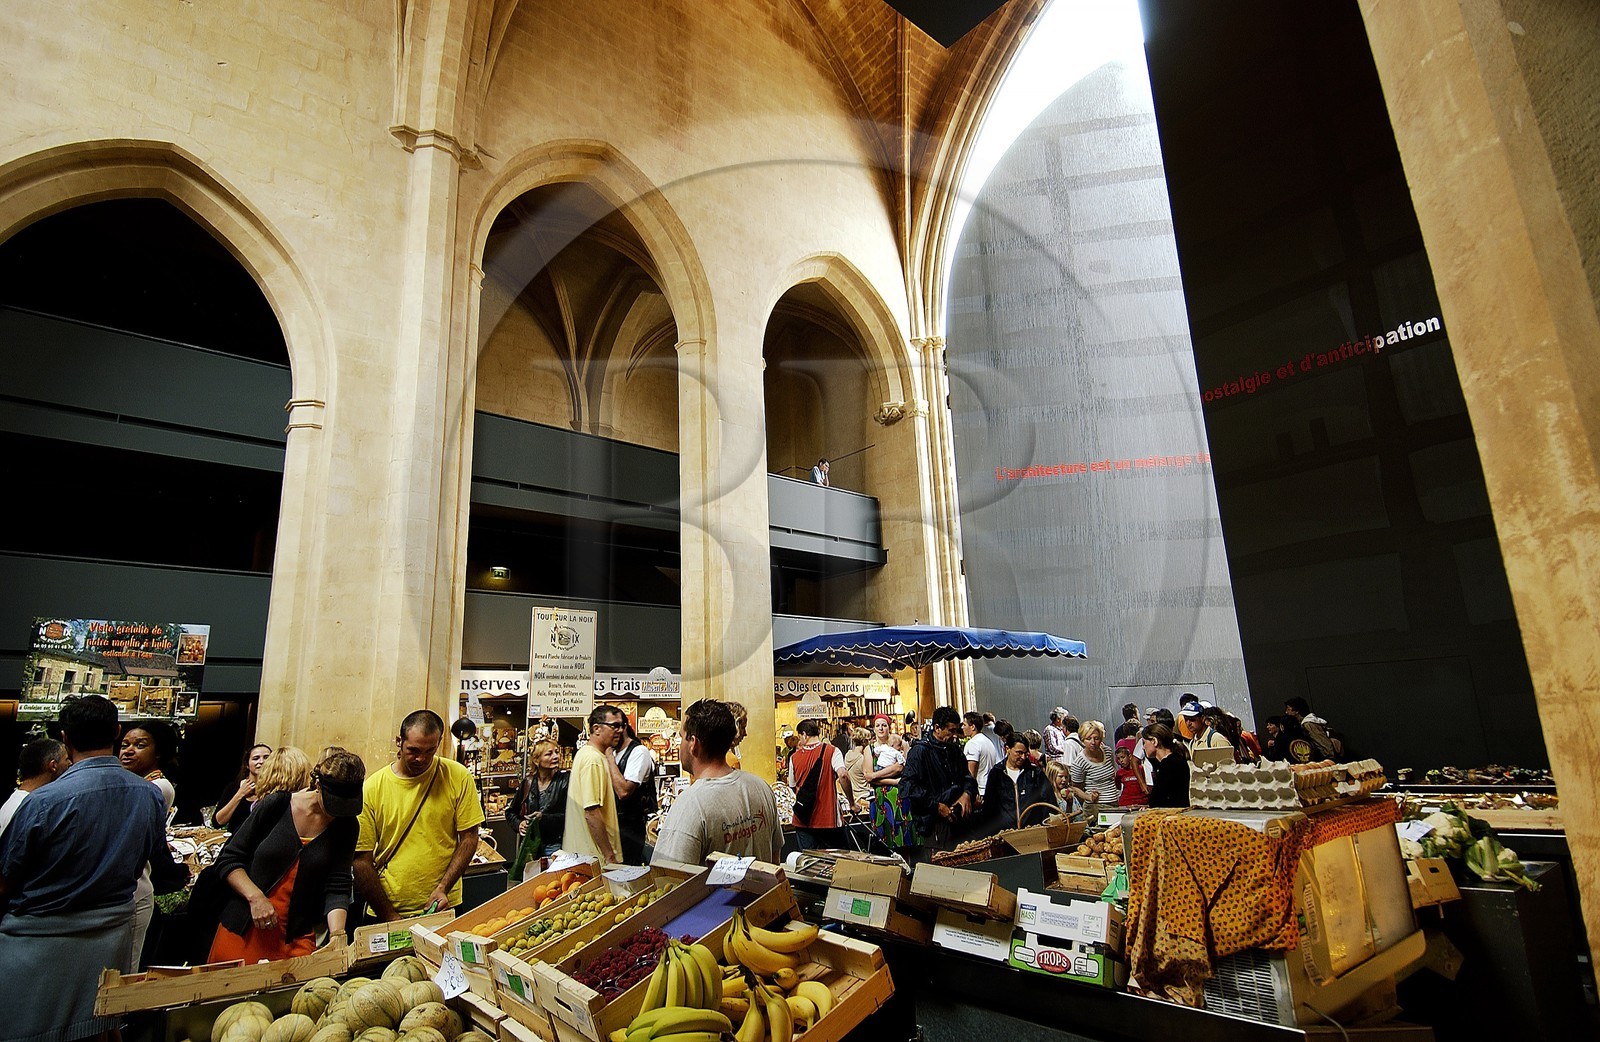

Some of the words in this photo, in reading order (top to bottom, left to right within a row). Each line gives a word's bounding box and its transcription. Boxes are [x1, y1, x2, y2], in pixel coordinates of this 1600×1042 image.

[1276, 361, 1295, 380] et
[1300, 316, 1441, 373] d'anticipation
[995, 462, 1087, 480] L'architecture
[1090, 459, 1111, 472] est
[1115, 460, 1131, 470] un
[537, 613, 552, 621] TOUT
[89, 622, 114, 633] Visite
[117, 624, 149, 635] gratuite
[152, 625, 163, 635] de
[86, 637, 109, 647] notre
[111, 635, 141, 648] moulin
[152, 637, 172, 649] huile
[574, 662, 585, 670] NOIX
[534, 671, 545, 680] NOIX
[461, 678, 520, 691] nserves
[611, 677, 640, 691] Frais
[787, 680, 809, 692] Oies
[812, 682, 821, 692] et
[824, 680, 859, 693] Canards
[1020, 910, 1034, 920] HASS
[1038, 951, 1067, 968] TROPS
